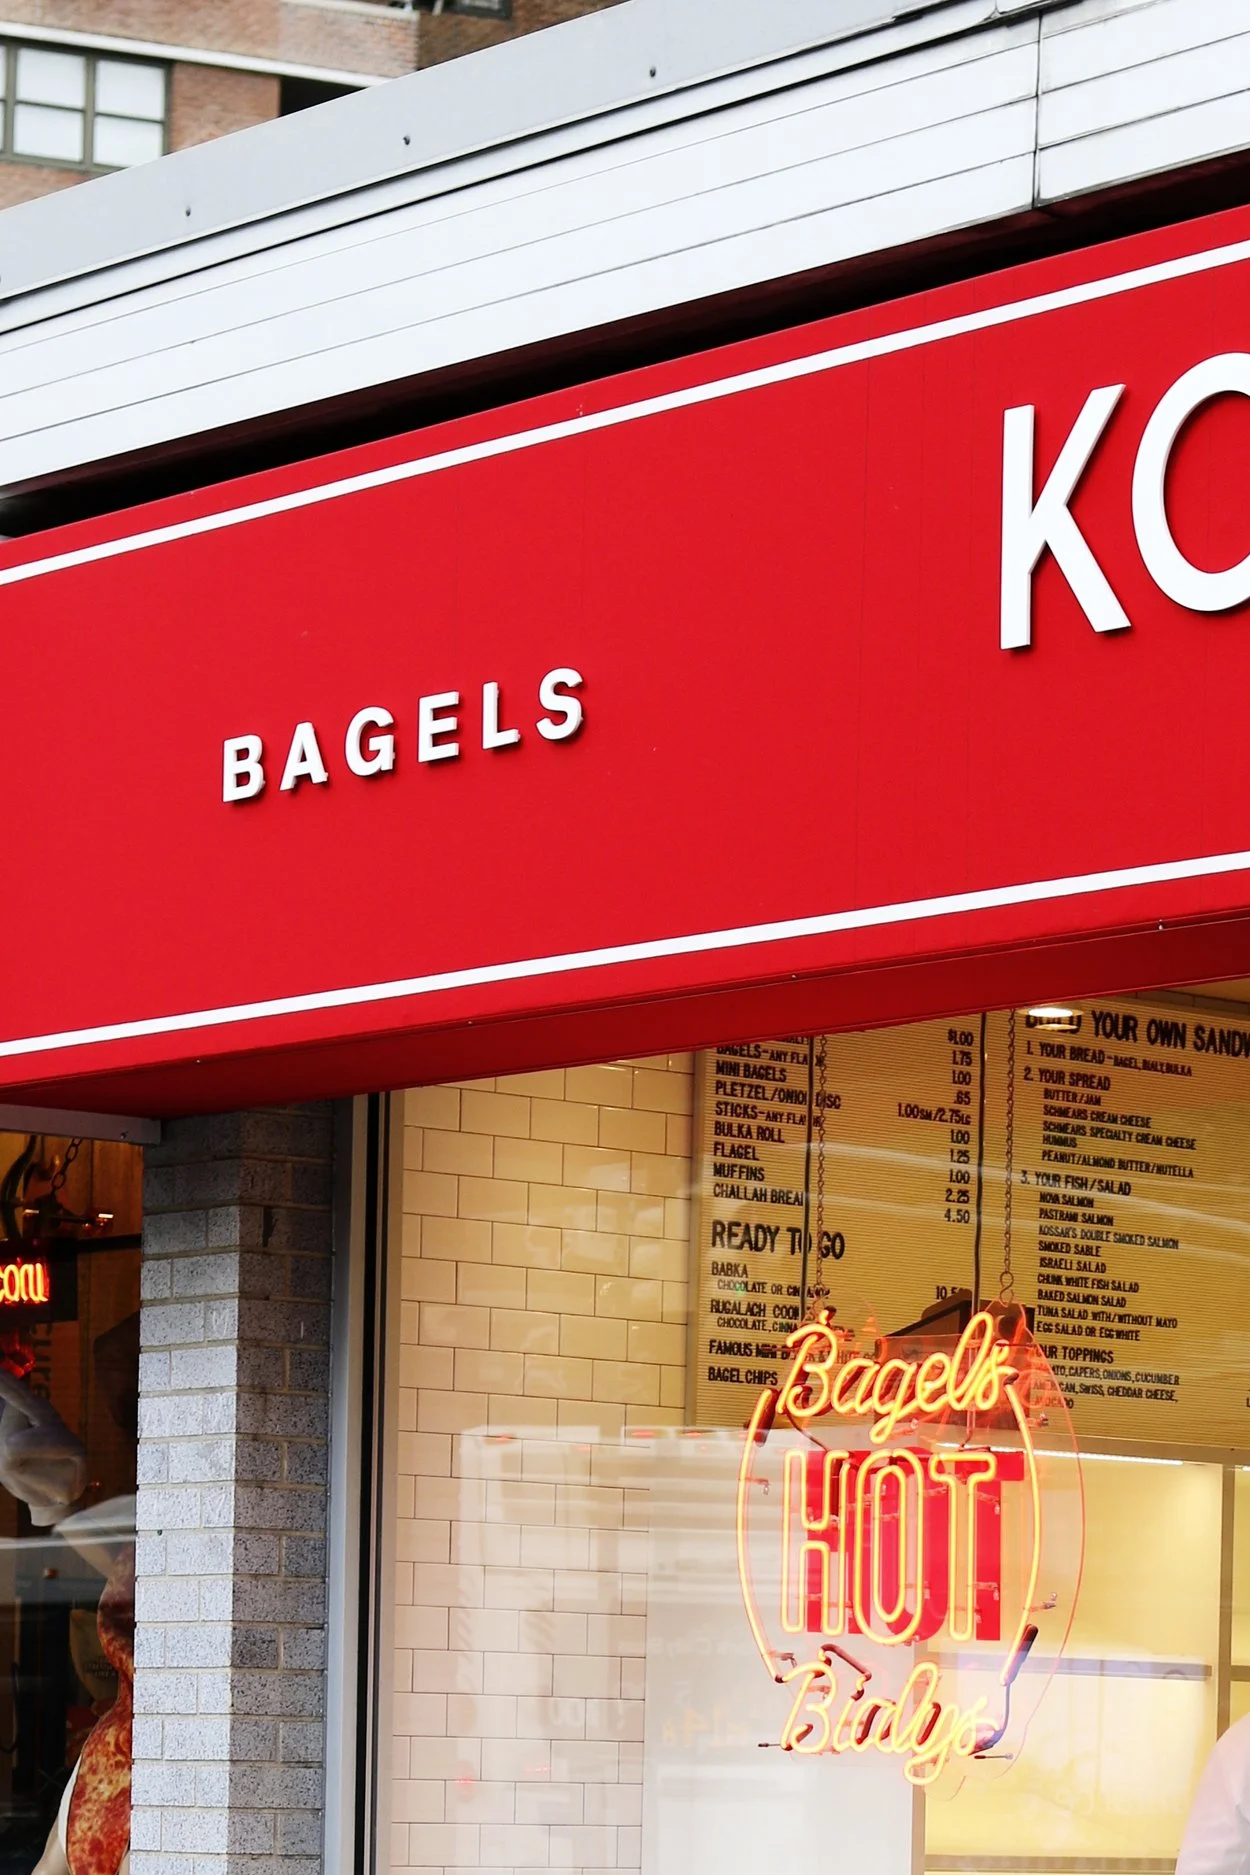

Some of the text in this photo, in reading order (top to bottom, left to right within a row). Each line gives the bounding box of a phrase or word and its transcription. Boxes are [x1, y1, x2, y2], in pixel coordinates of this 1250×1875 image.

[222, 667, 584, 802] BAGELS
[1091, 1010, 1138, 1043] YOUR
[1147, 1018, 1187, 1049] OWN
[1039, 1041, 1066, 1060] YOUR
[716, 1060, 787, 1082] MINI BAGELS
[1038, 1068, 1111, 1091] YOUR SPREAD
[714, 1121, 785, 1143] BULKA ROLL
[713, 1141, 760, 1160] FLAGEL
[713, 1163, 765, 1181] MUFFINS
[1035, 1171, 1060, 1188] YOUR
[713, 1183, 767, 1203] CHALLAH
[711, 1220, 780, 1254] READY
[820, 1231, 846, 1260] GO
[711, 1261, 749, 1279] BABKA
[1076, 1260, 1107, 1273] SALAD
[717, 1279, 767, 1295] CHOCOLATE
[710, 1300, 766, 1318] RUGALACH
[709, 1340, 753, 1357] FAMOUS
[1062, 1346, 1114, 1364] TOPPINGS
[708, 1366, 778, 1386] BAGEL CHIPS
[776, 1311, 1019, 1445] Bagels
[781, 1447, 1002, 1646] HOT
[779, 1661, 998, 1785] Bialys
